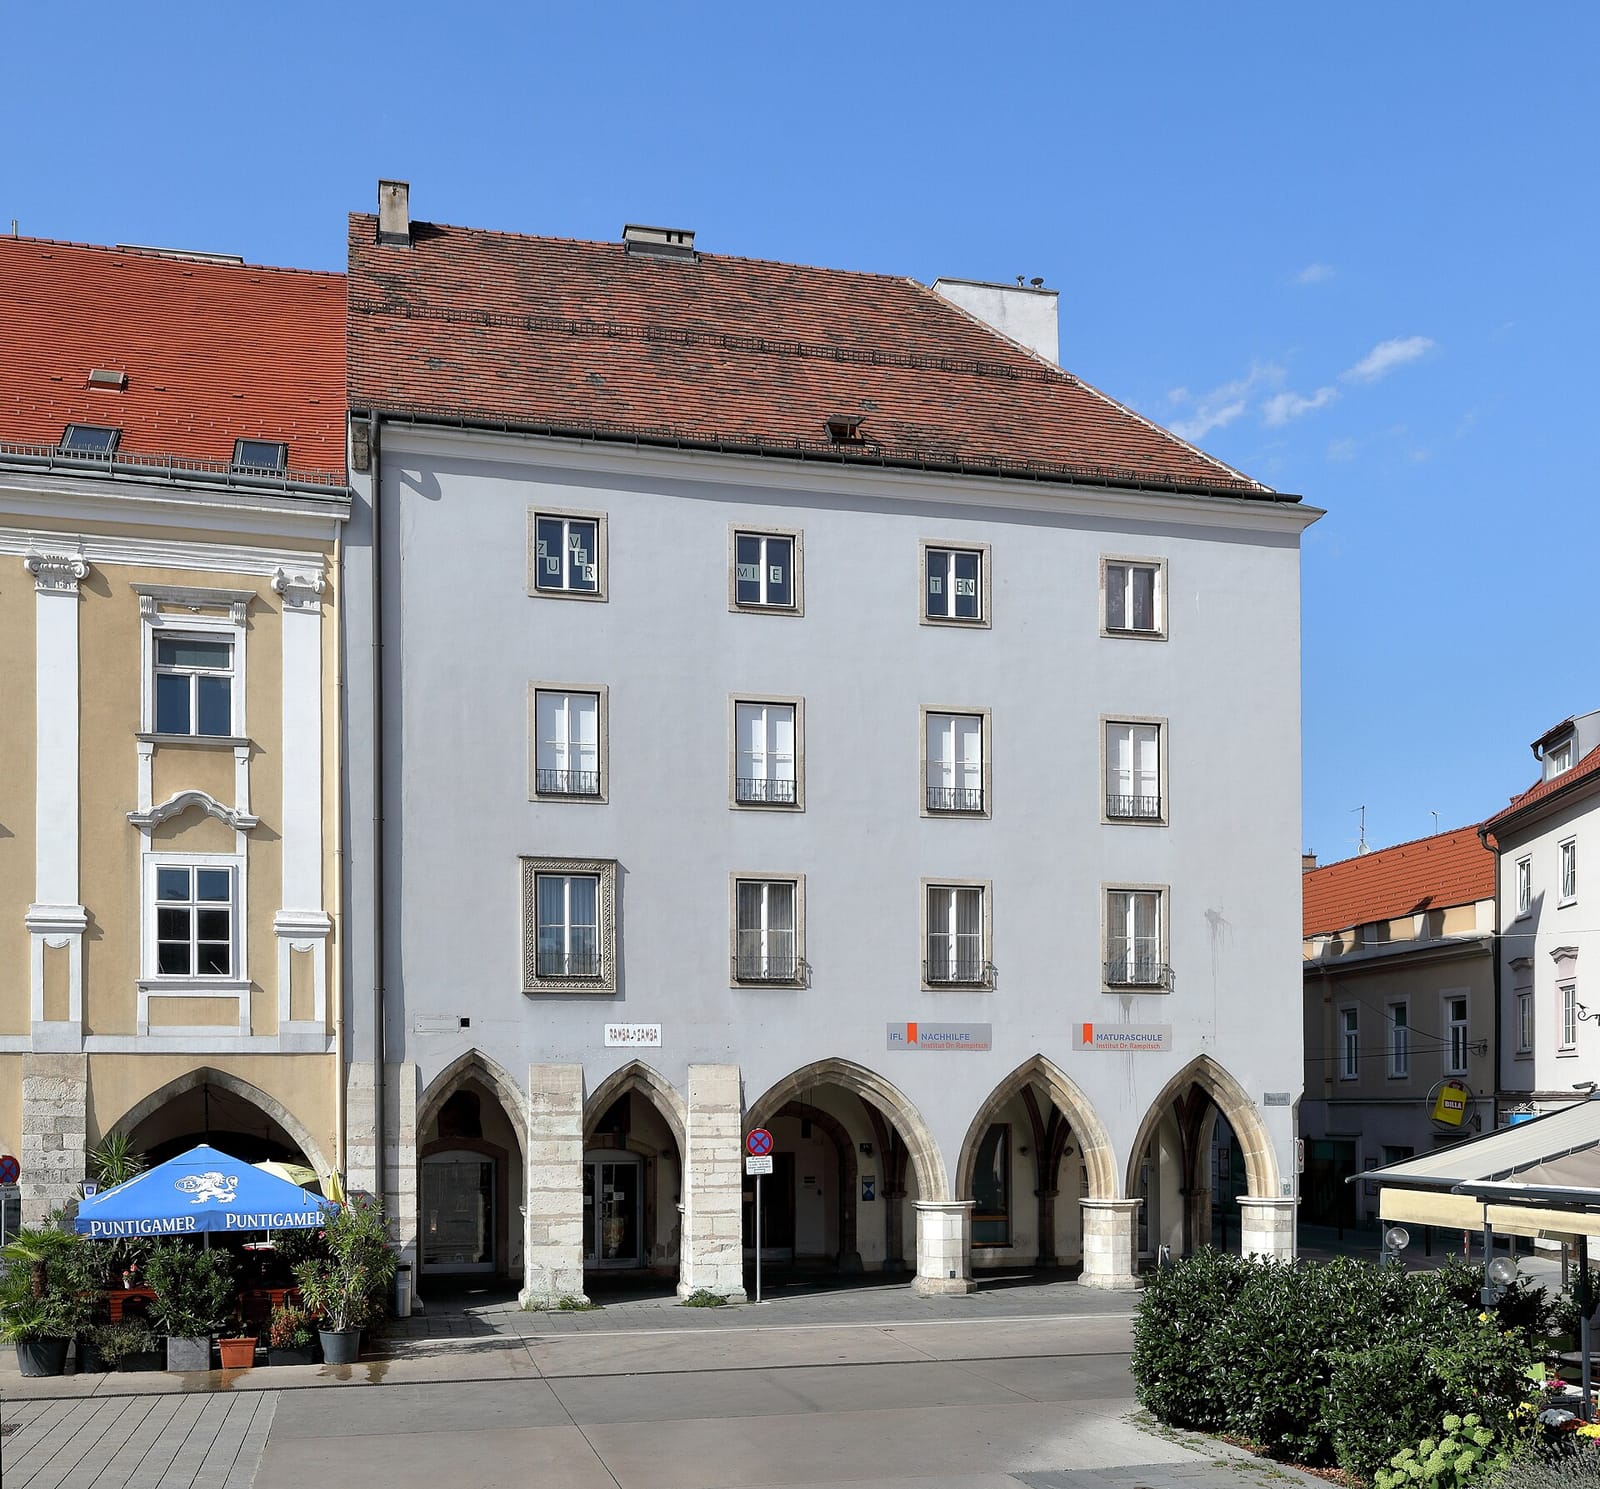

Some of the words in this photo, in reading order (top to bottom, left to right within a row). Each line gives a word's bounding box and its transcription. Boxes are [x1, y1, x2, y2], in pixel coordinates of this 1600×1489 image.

[921, 1033, 971, 1041] NACHHILFE
[1444, 1100, 1462, 1109] BILLA
[90, 1216, 196, 1236] PUNTIGAMER
[225, 1211, 325, 1228] PUNTIGAMER
